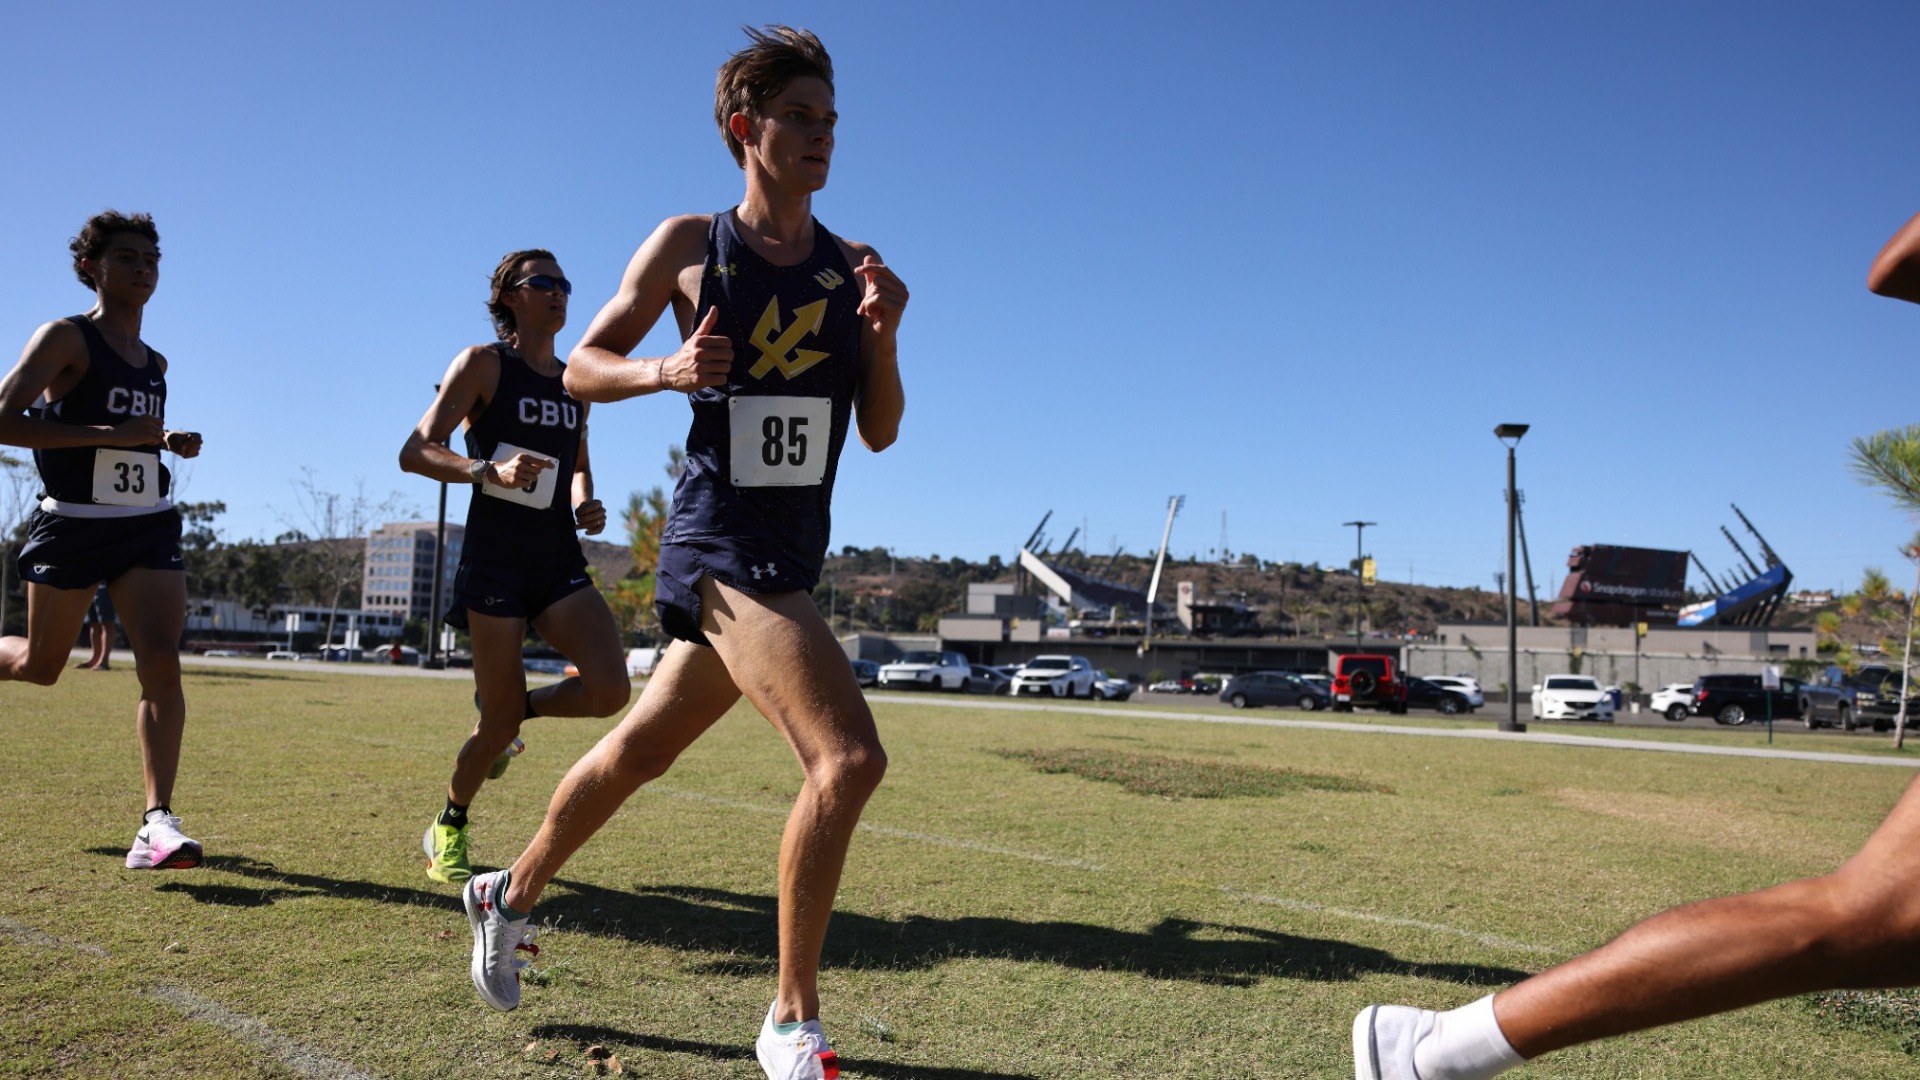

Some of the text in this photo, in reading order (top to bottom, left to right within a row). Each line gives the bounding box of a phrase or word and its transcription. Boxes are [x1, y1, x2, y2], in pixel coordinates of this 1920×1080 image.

[518, 397, 577, 430] CBU
[761, 415, 809, 467] 85
[113, 462, 145, 494] 33
[1592, 581, 1648, 598] Snapdragon
